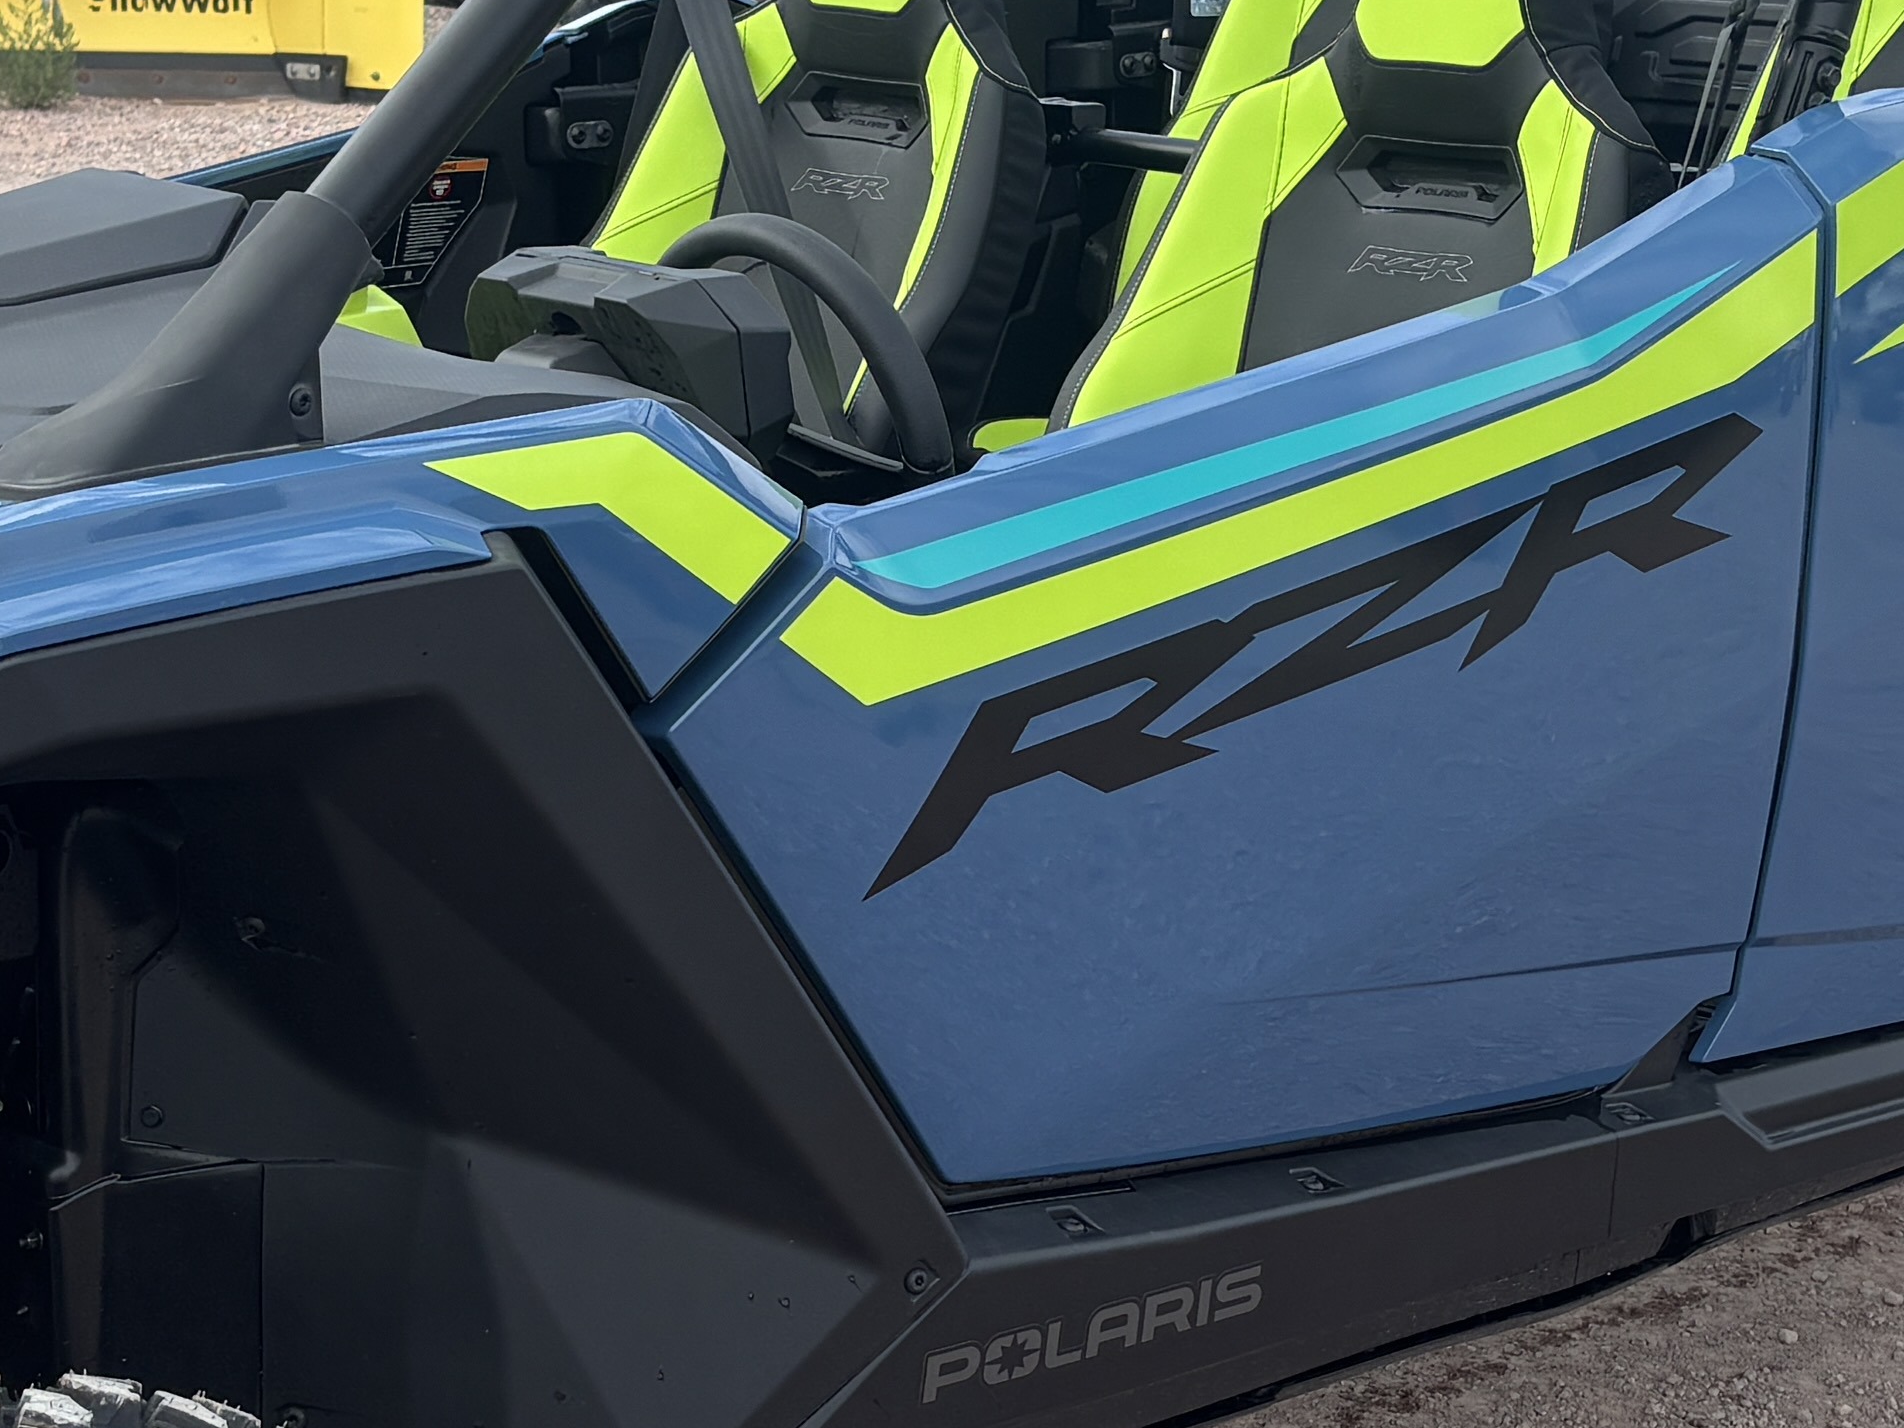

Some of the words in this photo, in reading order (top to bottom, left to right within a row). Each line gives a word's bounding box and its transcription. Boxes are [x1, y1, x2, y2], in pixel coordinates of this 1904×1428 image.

[790, 167, 890, 201] RZR
[1347, 244, 1474, 283] RZR
[860, 412, 1763, 903] RZR
[921, 1264, 1264, 1404] POLARIS
